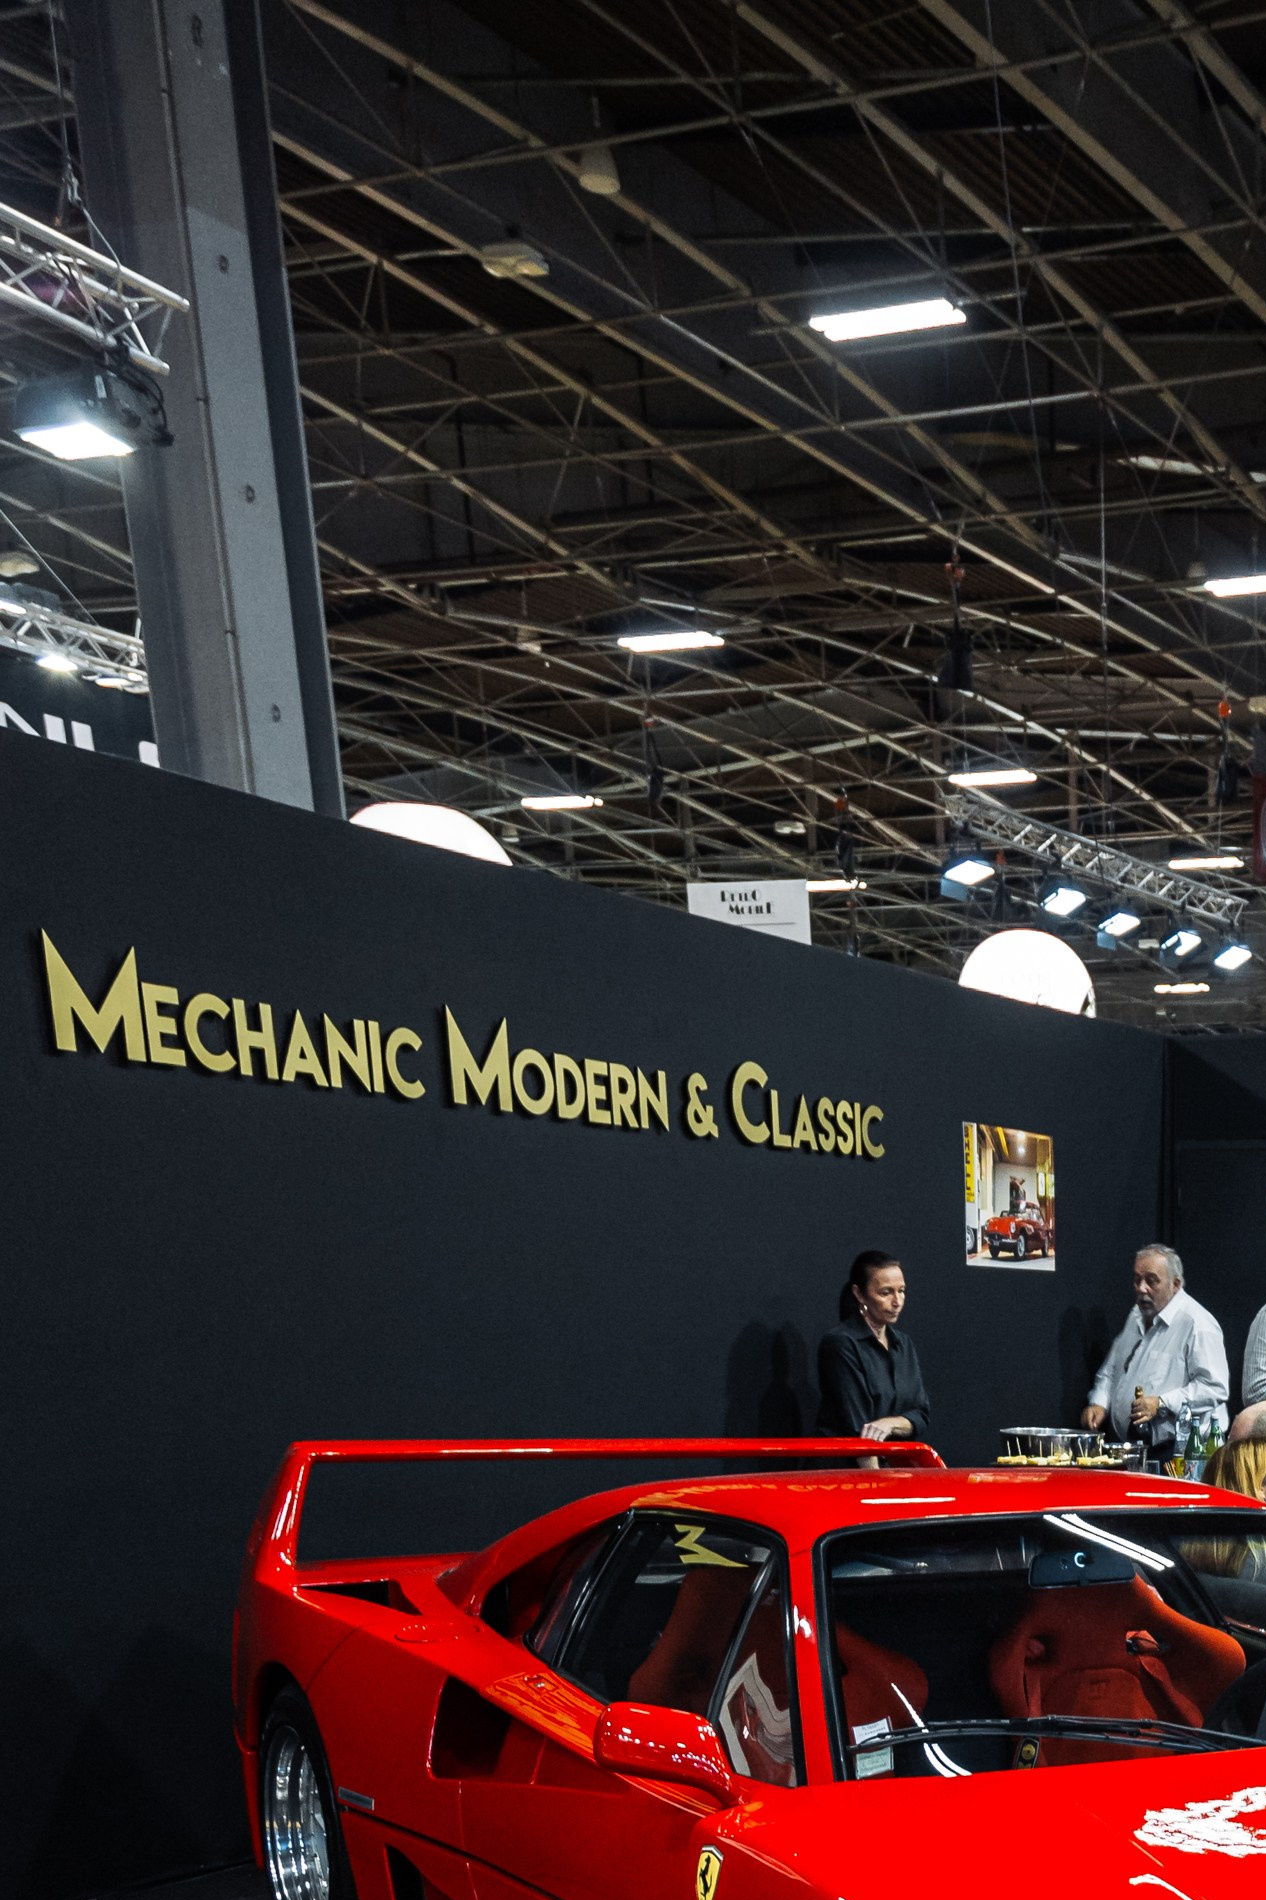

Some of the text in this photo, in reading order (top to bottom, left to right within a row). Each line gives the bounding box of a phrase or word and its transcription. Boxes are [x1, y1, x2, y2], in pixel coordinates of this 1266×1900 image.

[41, 927, 886, 1159] MECHANIC MODERN & CLASSIC
